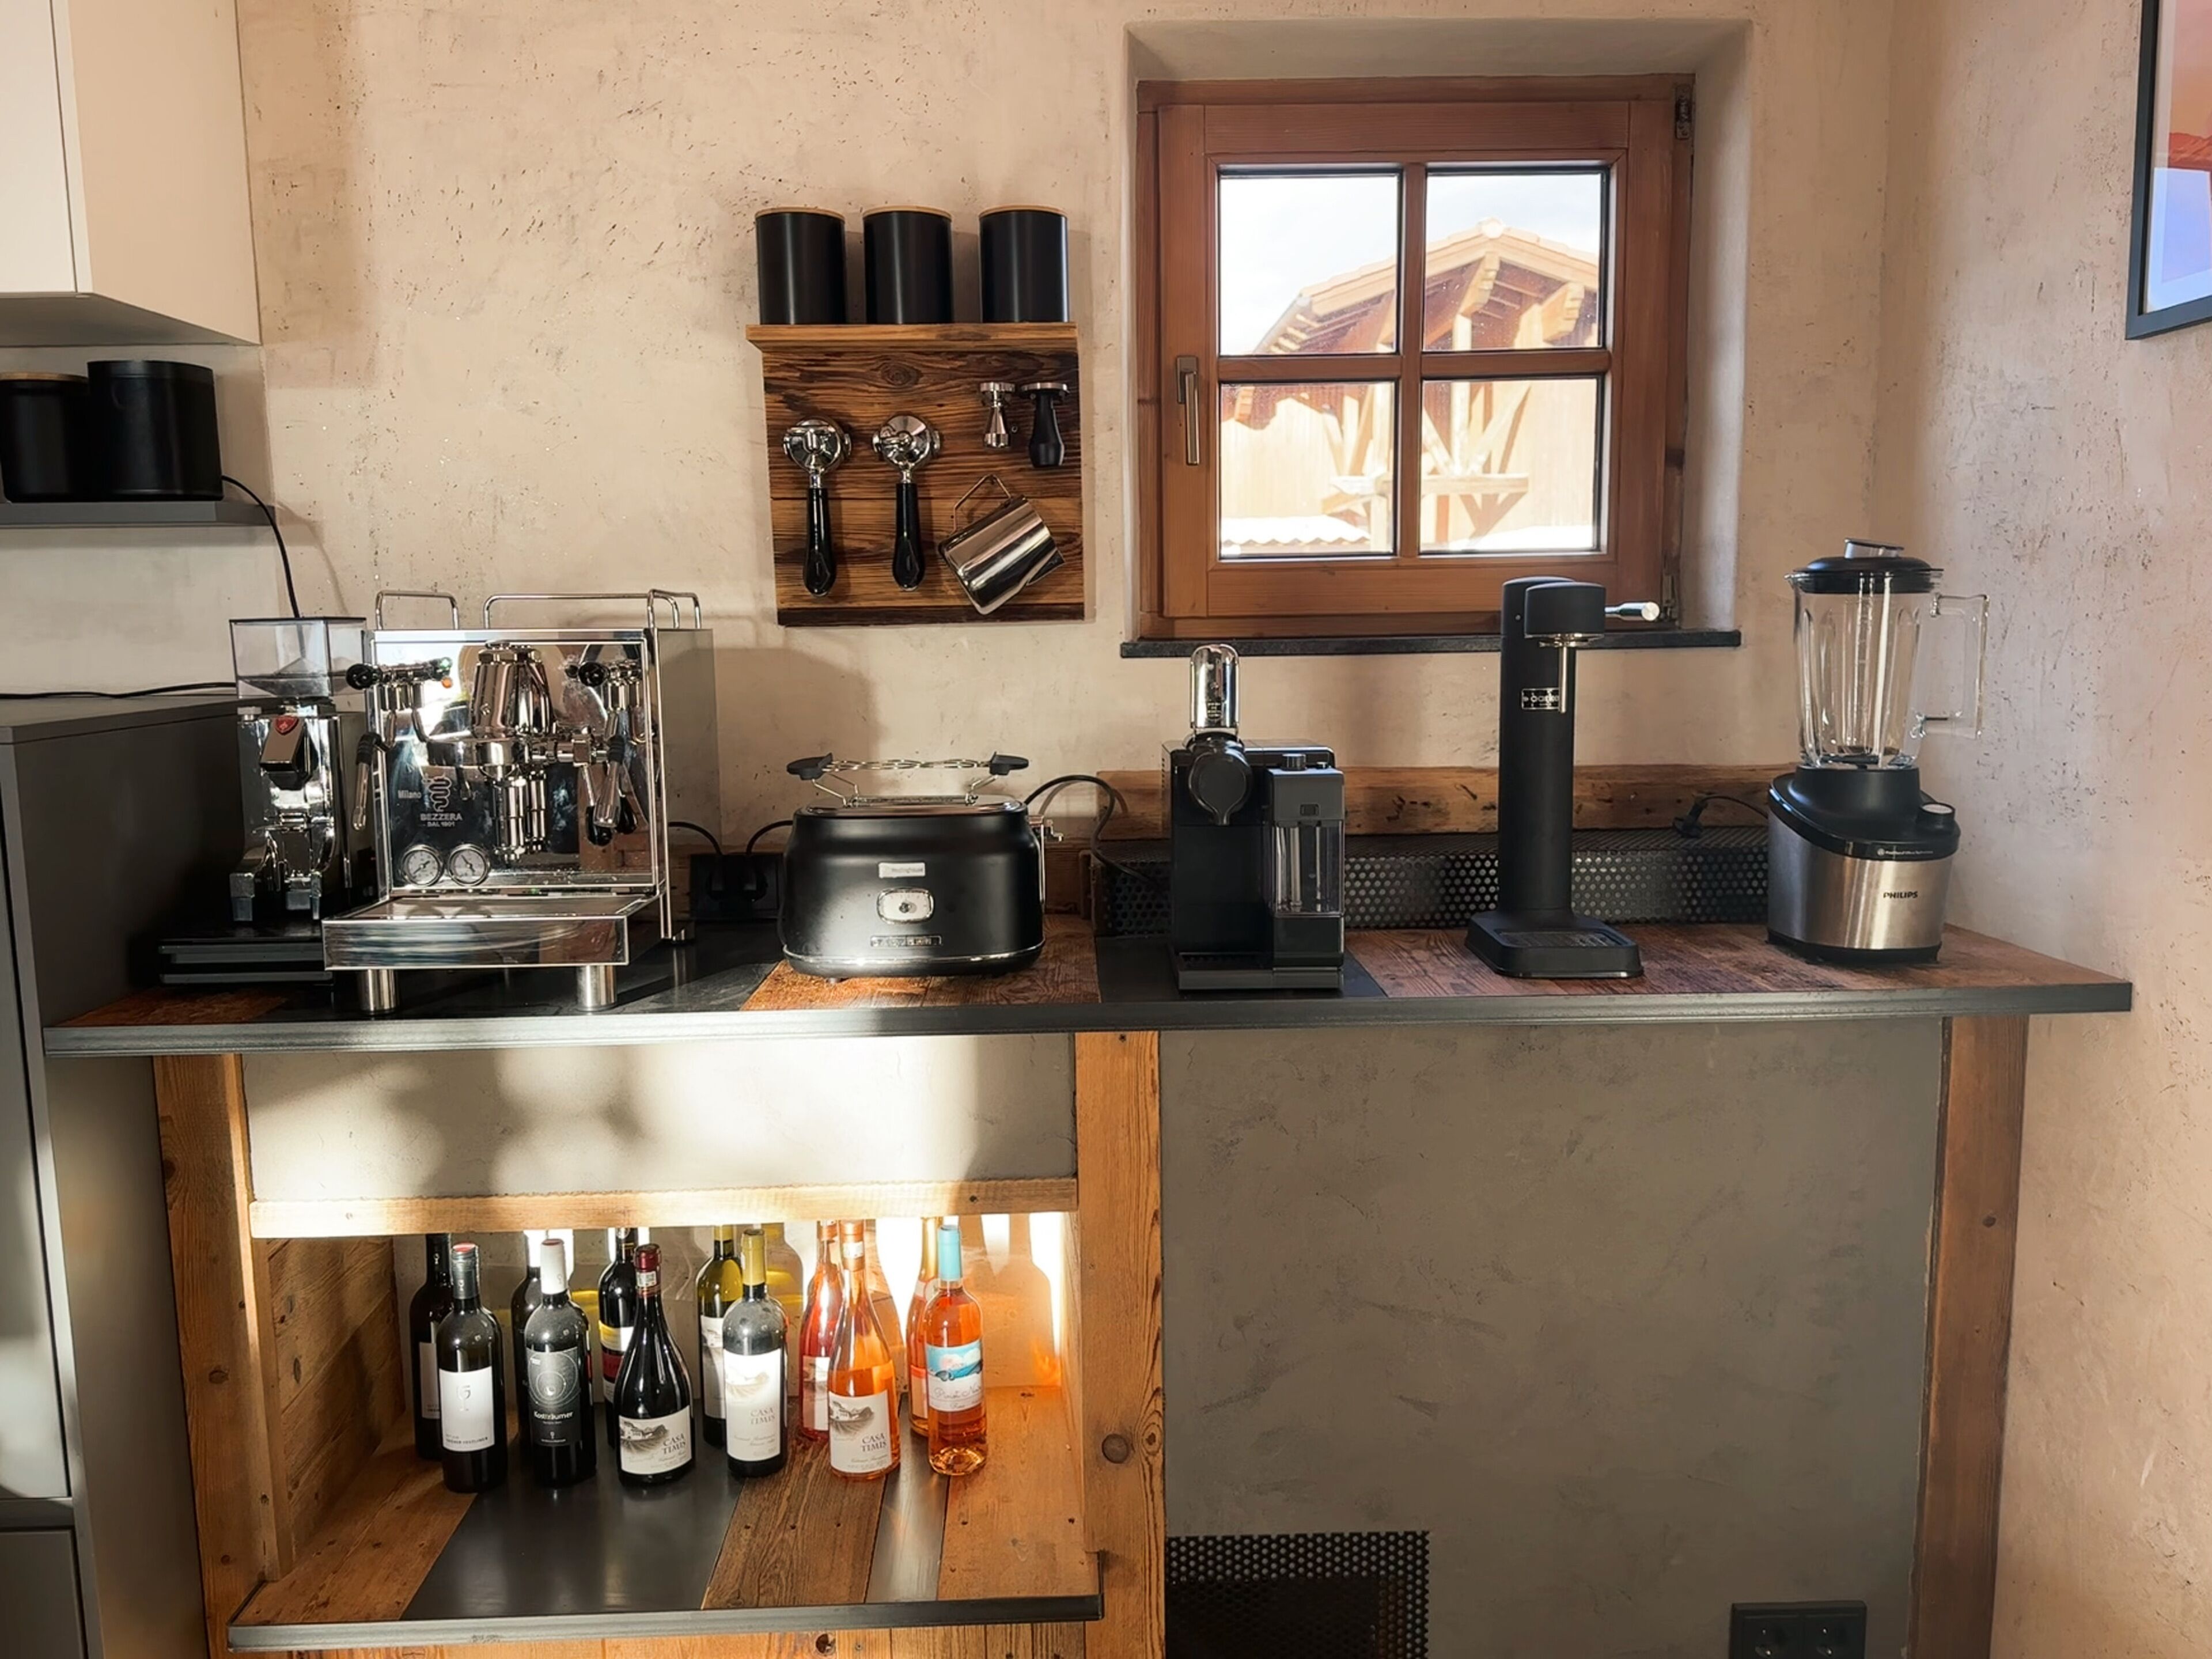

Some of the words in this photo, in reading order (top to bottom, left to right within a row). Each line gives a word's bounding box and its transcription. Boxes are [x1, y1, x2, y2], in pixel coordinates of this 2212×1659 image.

[397, 790, 422, 799] Milano
[420, 813, 463, 821] BEZZERA
[1883, 891, 1918, 899] PHILIPS
[750, 1407, 774, 1417] CASA
[663, 1433, 685, 1446] CASA
[862, 1433, 885, 1444] CASA
[662, 1441, 687, 1455] TIMIS
[861, 1441, 887, 1452] TIMIS
